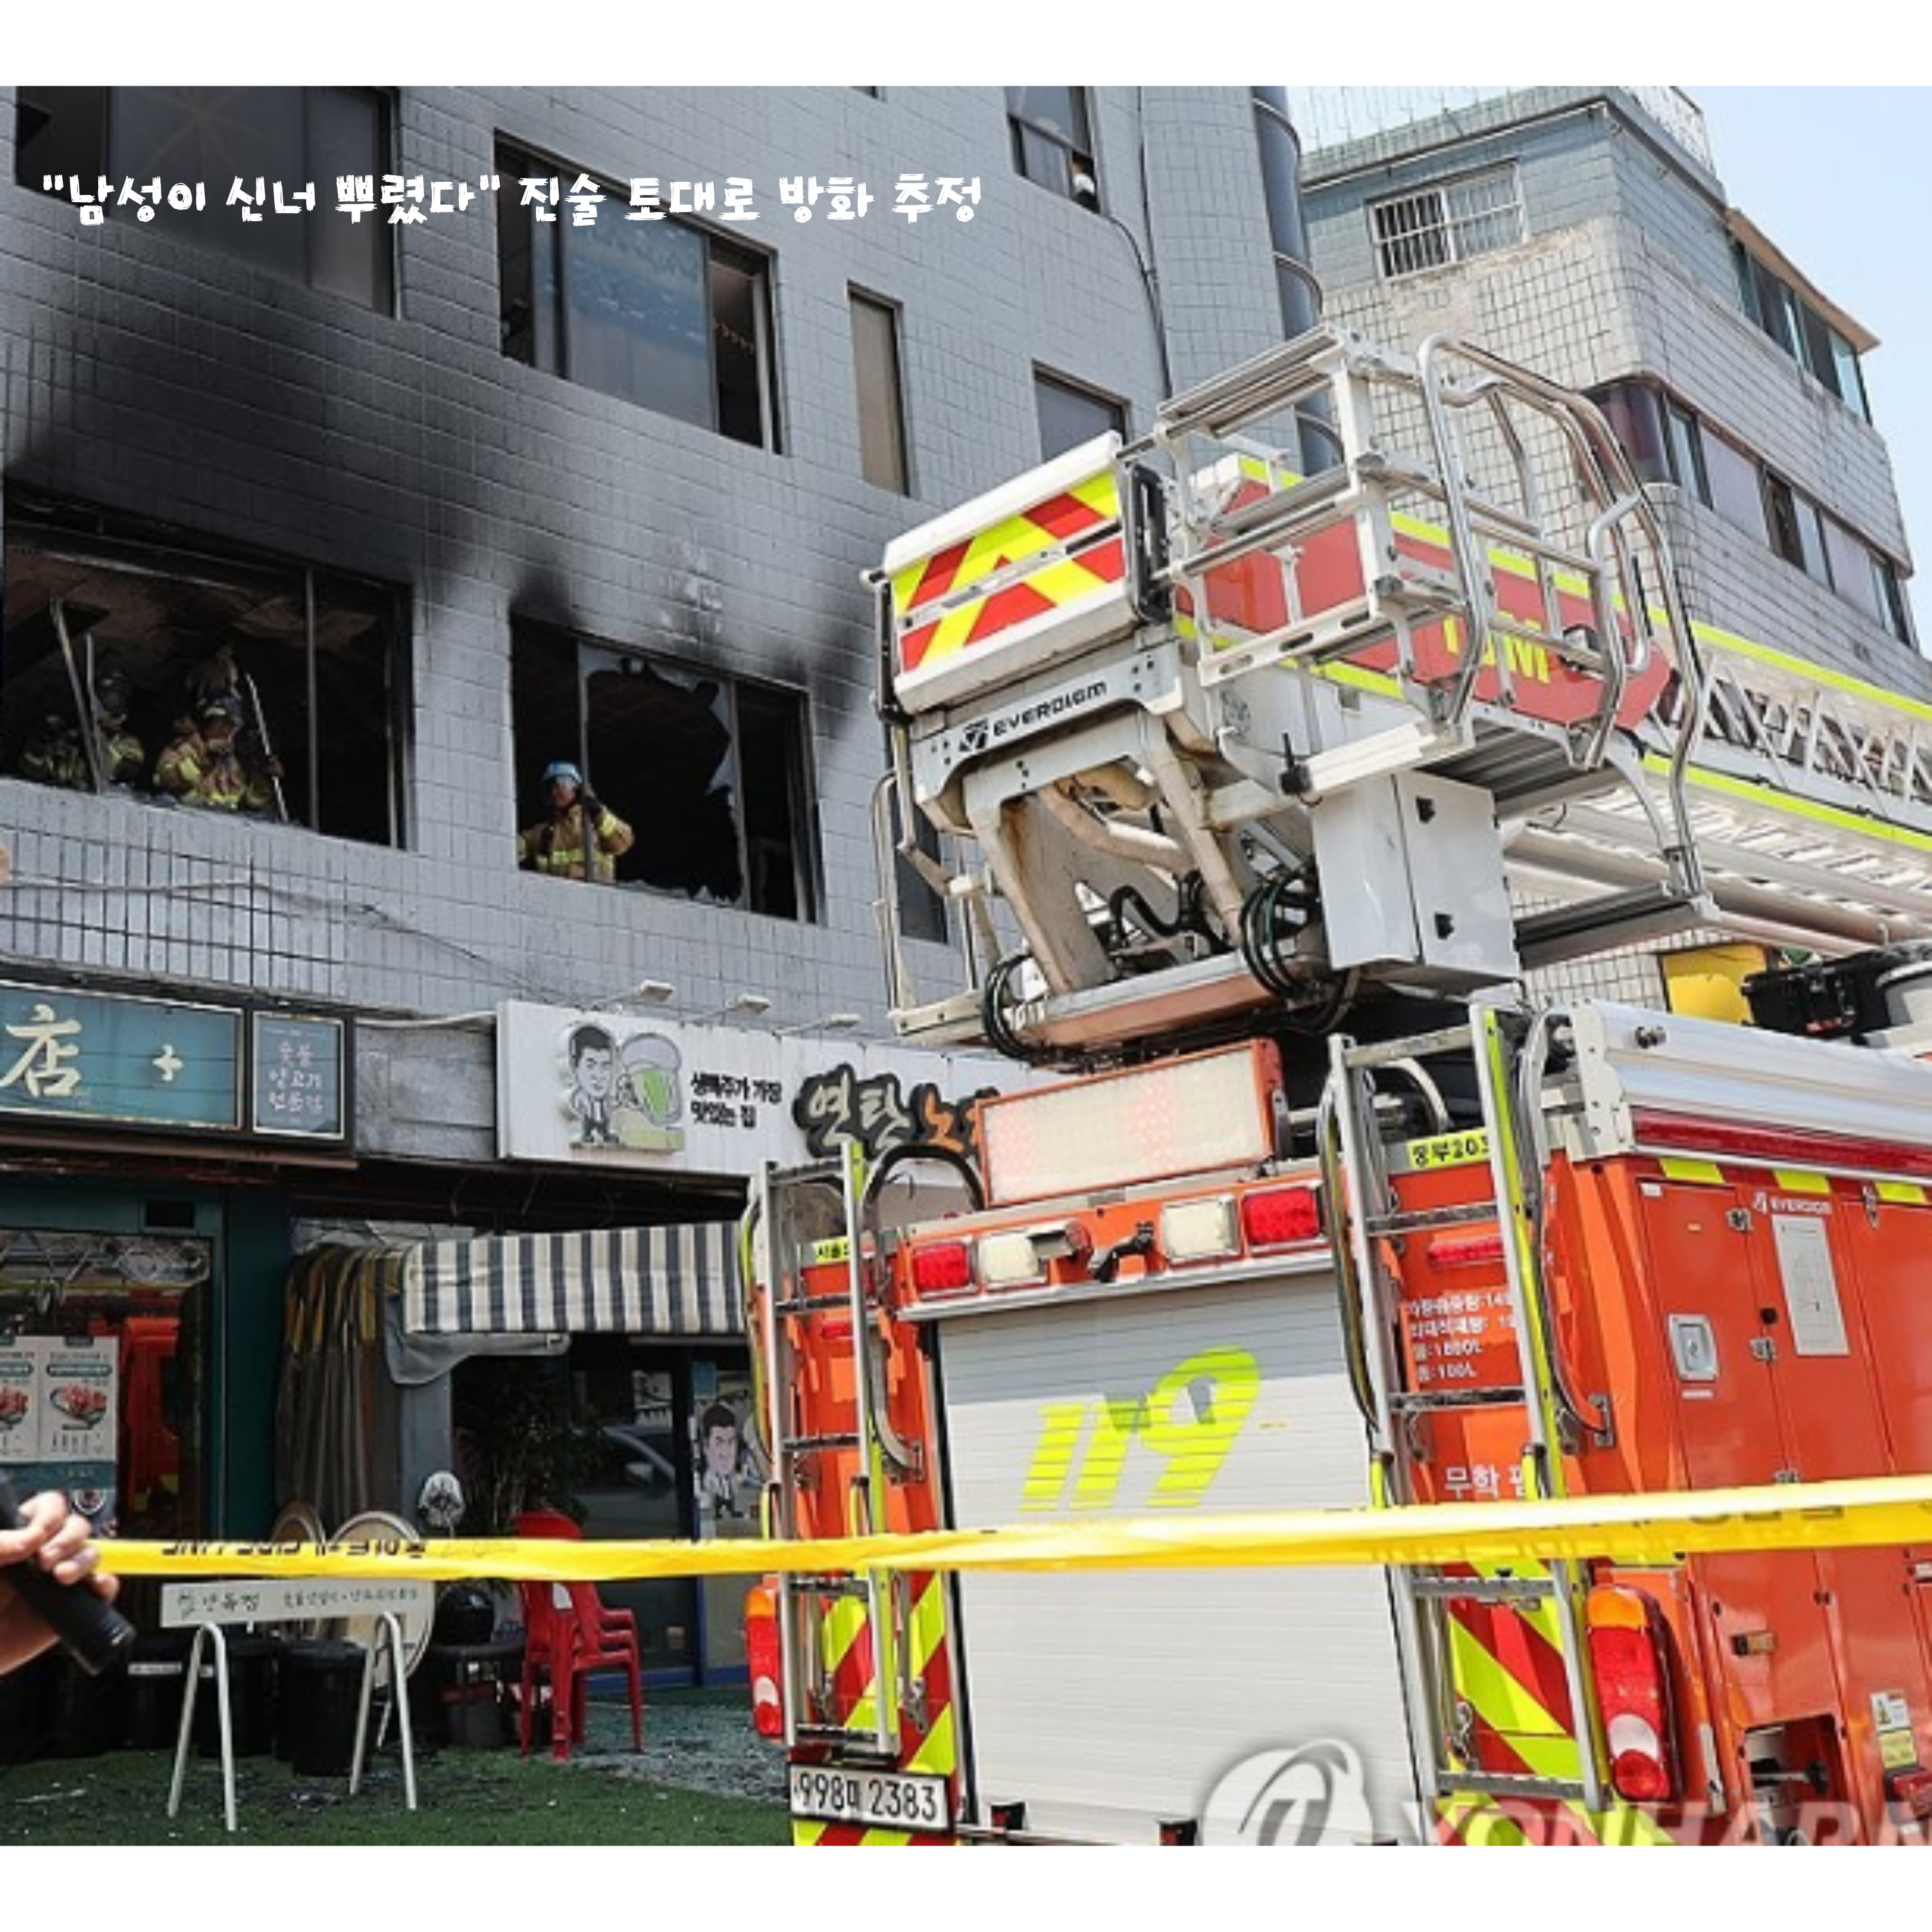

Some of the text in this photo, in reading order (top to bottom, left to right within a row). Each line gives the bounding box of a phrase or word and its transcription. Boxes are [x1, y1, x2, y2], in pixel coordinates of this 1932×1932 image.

[0, 1004, 82, 1098] 店
[752, 1080, 782, 1104] 가장
[691, 1101, 756, 1127] 맛있는 집
[1019, 1344, 1260, 1512] 119
[1444, 1464, 1501, 1500] 무학
[869, 1778, 937, 1821] 2383
